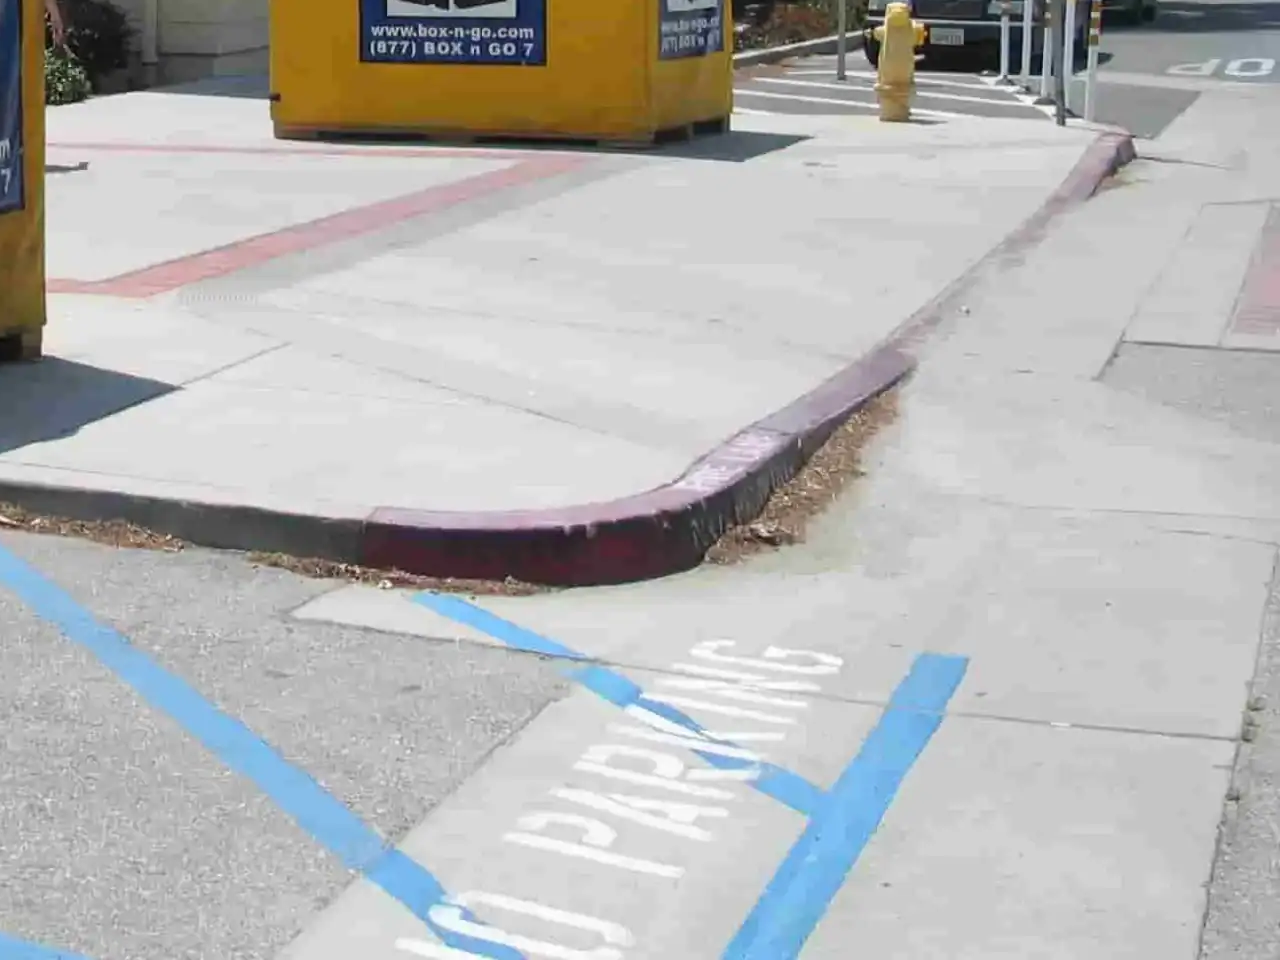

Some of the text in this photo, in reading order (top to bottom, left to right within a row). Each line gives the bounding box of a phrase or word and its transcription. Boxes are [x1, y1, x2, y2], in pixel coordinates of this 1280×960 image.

[371, 24, 534, 41] www.box-n-go.com
[370, 41, 534, 58] (877) BOX n GO 7
[1, 168, 11, 194] 7
[500, 639, 844, 878] PARKING
